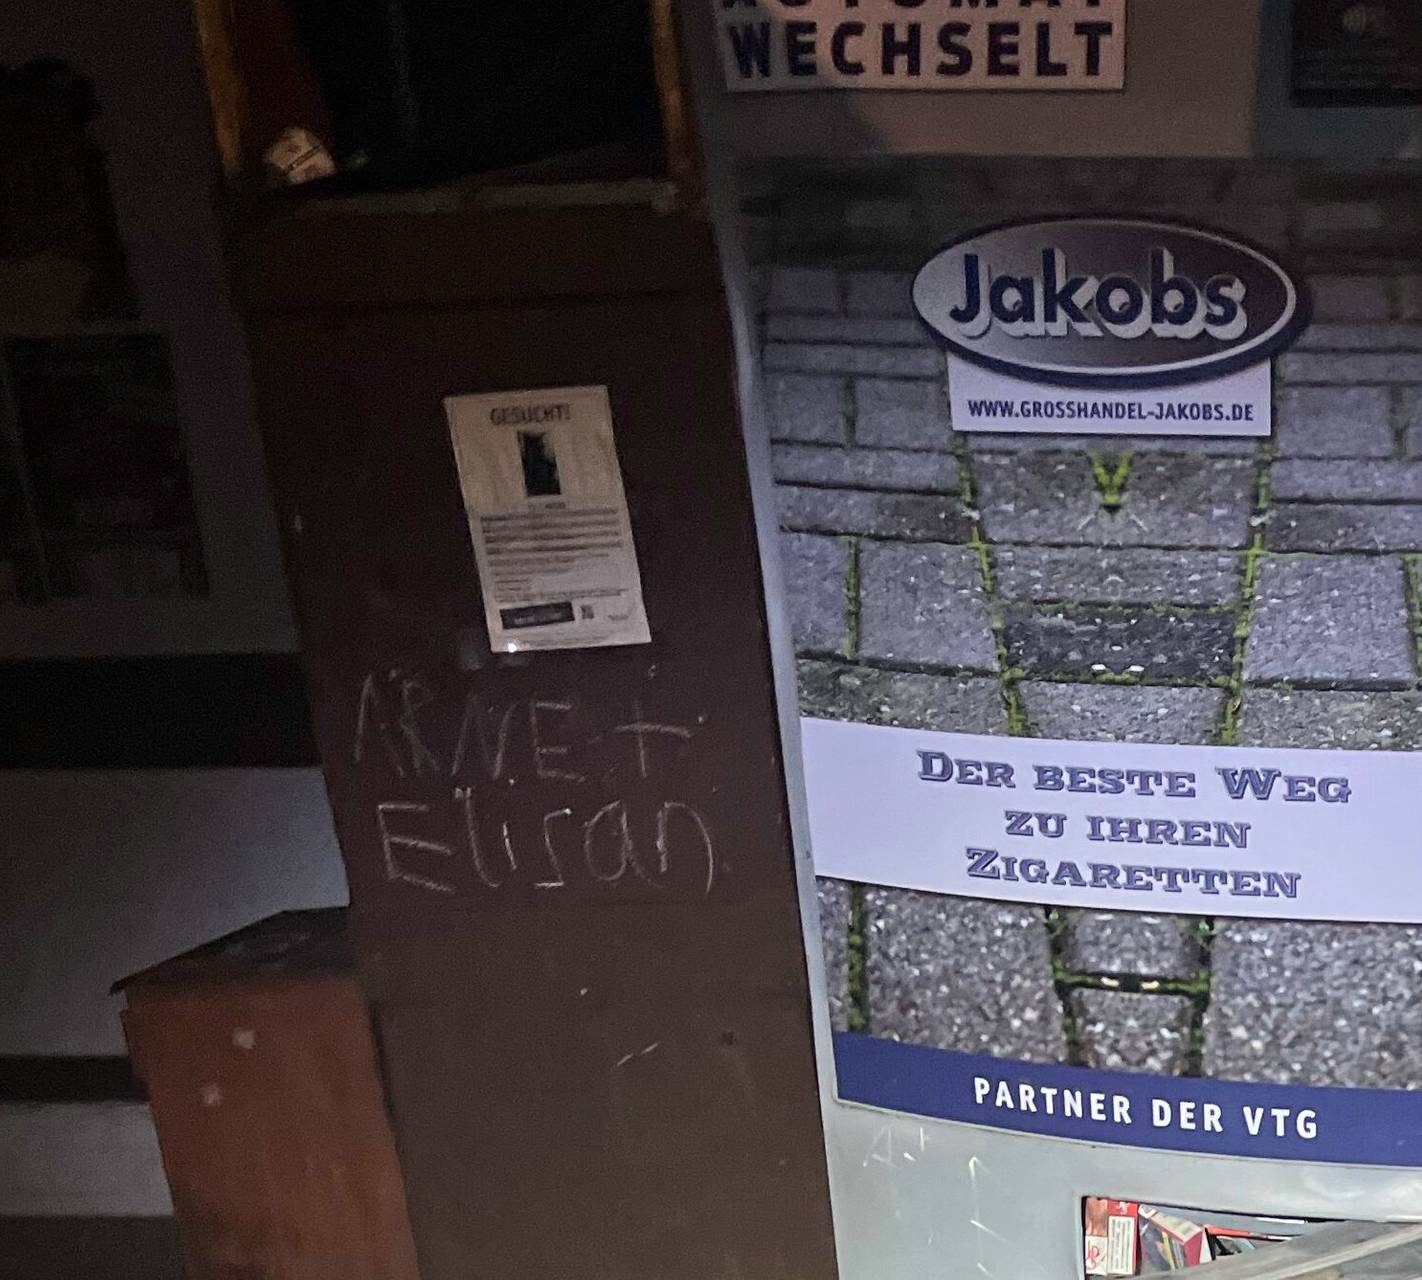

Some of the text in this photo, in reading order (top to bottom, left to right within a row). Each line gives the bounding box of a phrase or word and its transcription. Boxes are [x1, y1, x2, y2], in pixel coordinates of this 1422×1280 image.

[730, 20, 1113, 79] WECHSELT
[949, 246, 1248, 340] Jakobs
[489, 403, 571, 426] GESUCHT!
[967, 398, 1255, 422] WWW.GROSSHANDEL-JAKOBS.DE
[973, 1076, 1318, 1140] PARTNER DER VTG
